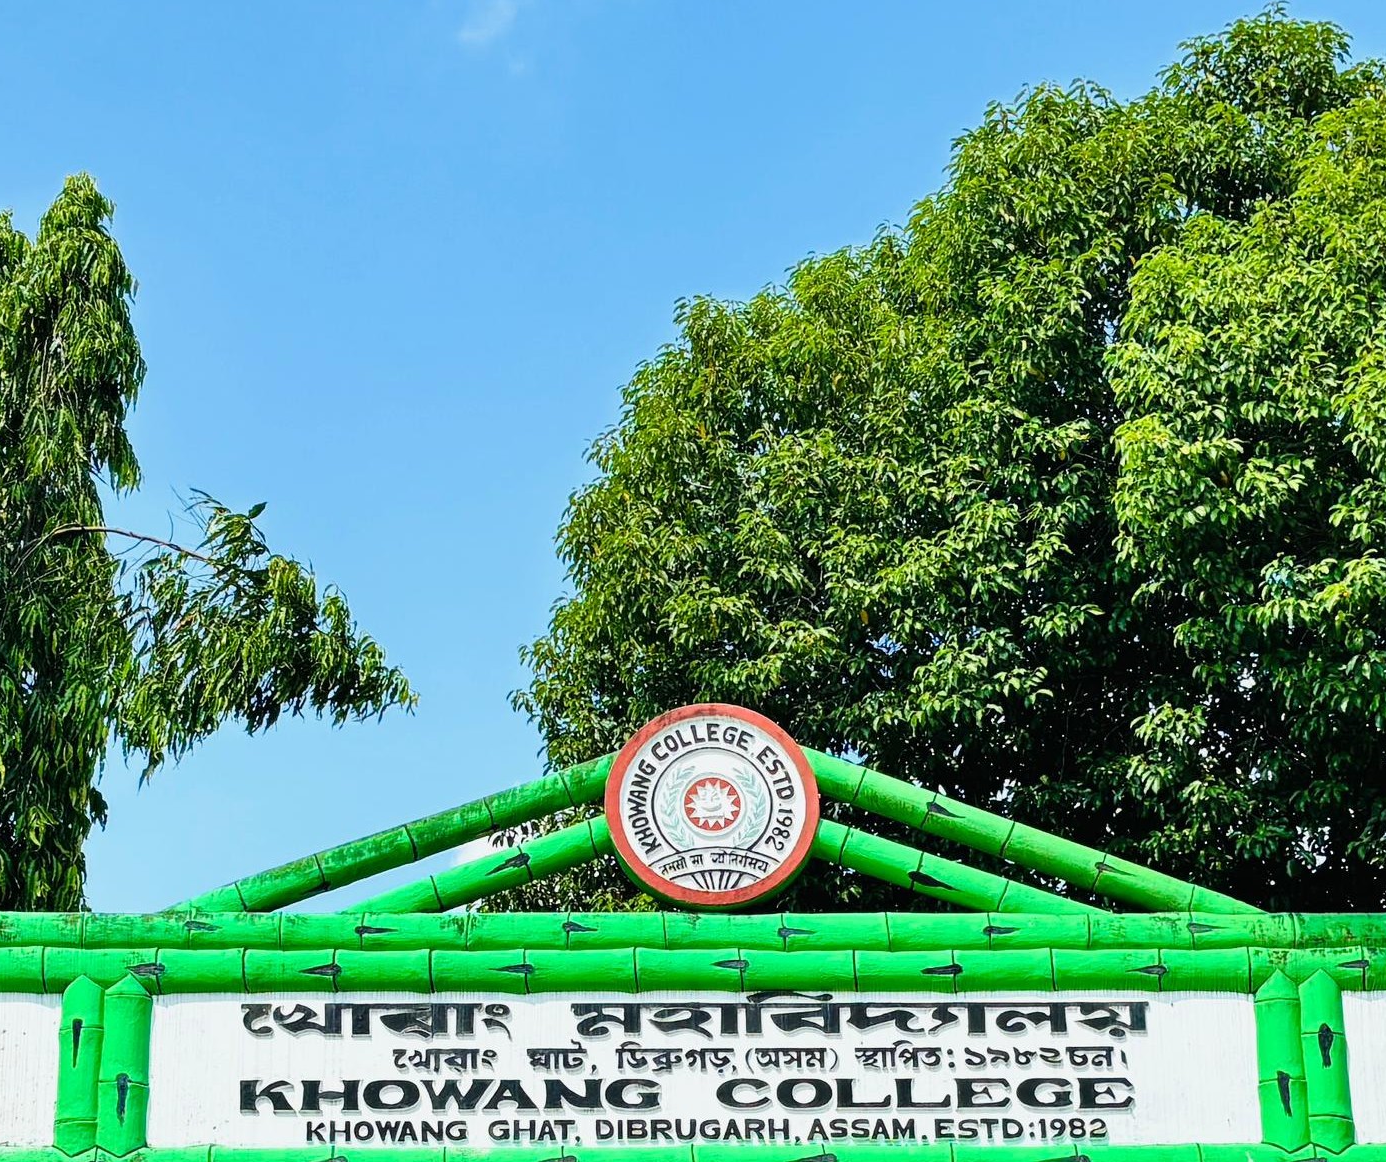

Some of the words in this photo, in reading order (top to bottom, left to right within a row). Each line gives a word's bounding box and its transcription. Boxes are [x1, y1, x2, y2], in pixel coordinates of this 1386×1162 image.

[627, 758, 662, 855] KHOWANG
[570, 990, 1149, 1038] মহাবিদ্যালয়
[239, 1078, 663, 1111] KHOWANG
[715, 1077, 1137, 1111] COLLEGE
[305, 1119, 468, 1143] KHOWANG
[487, 1118, 581, 1145] GHAT,
